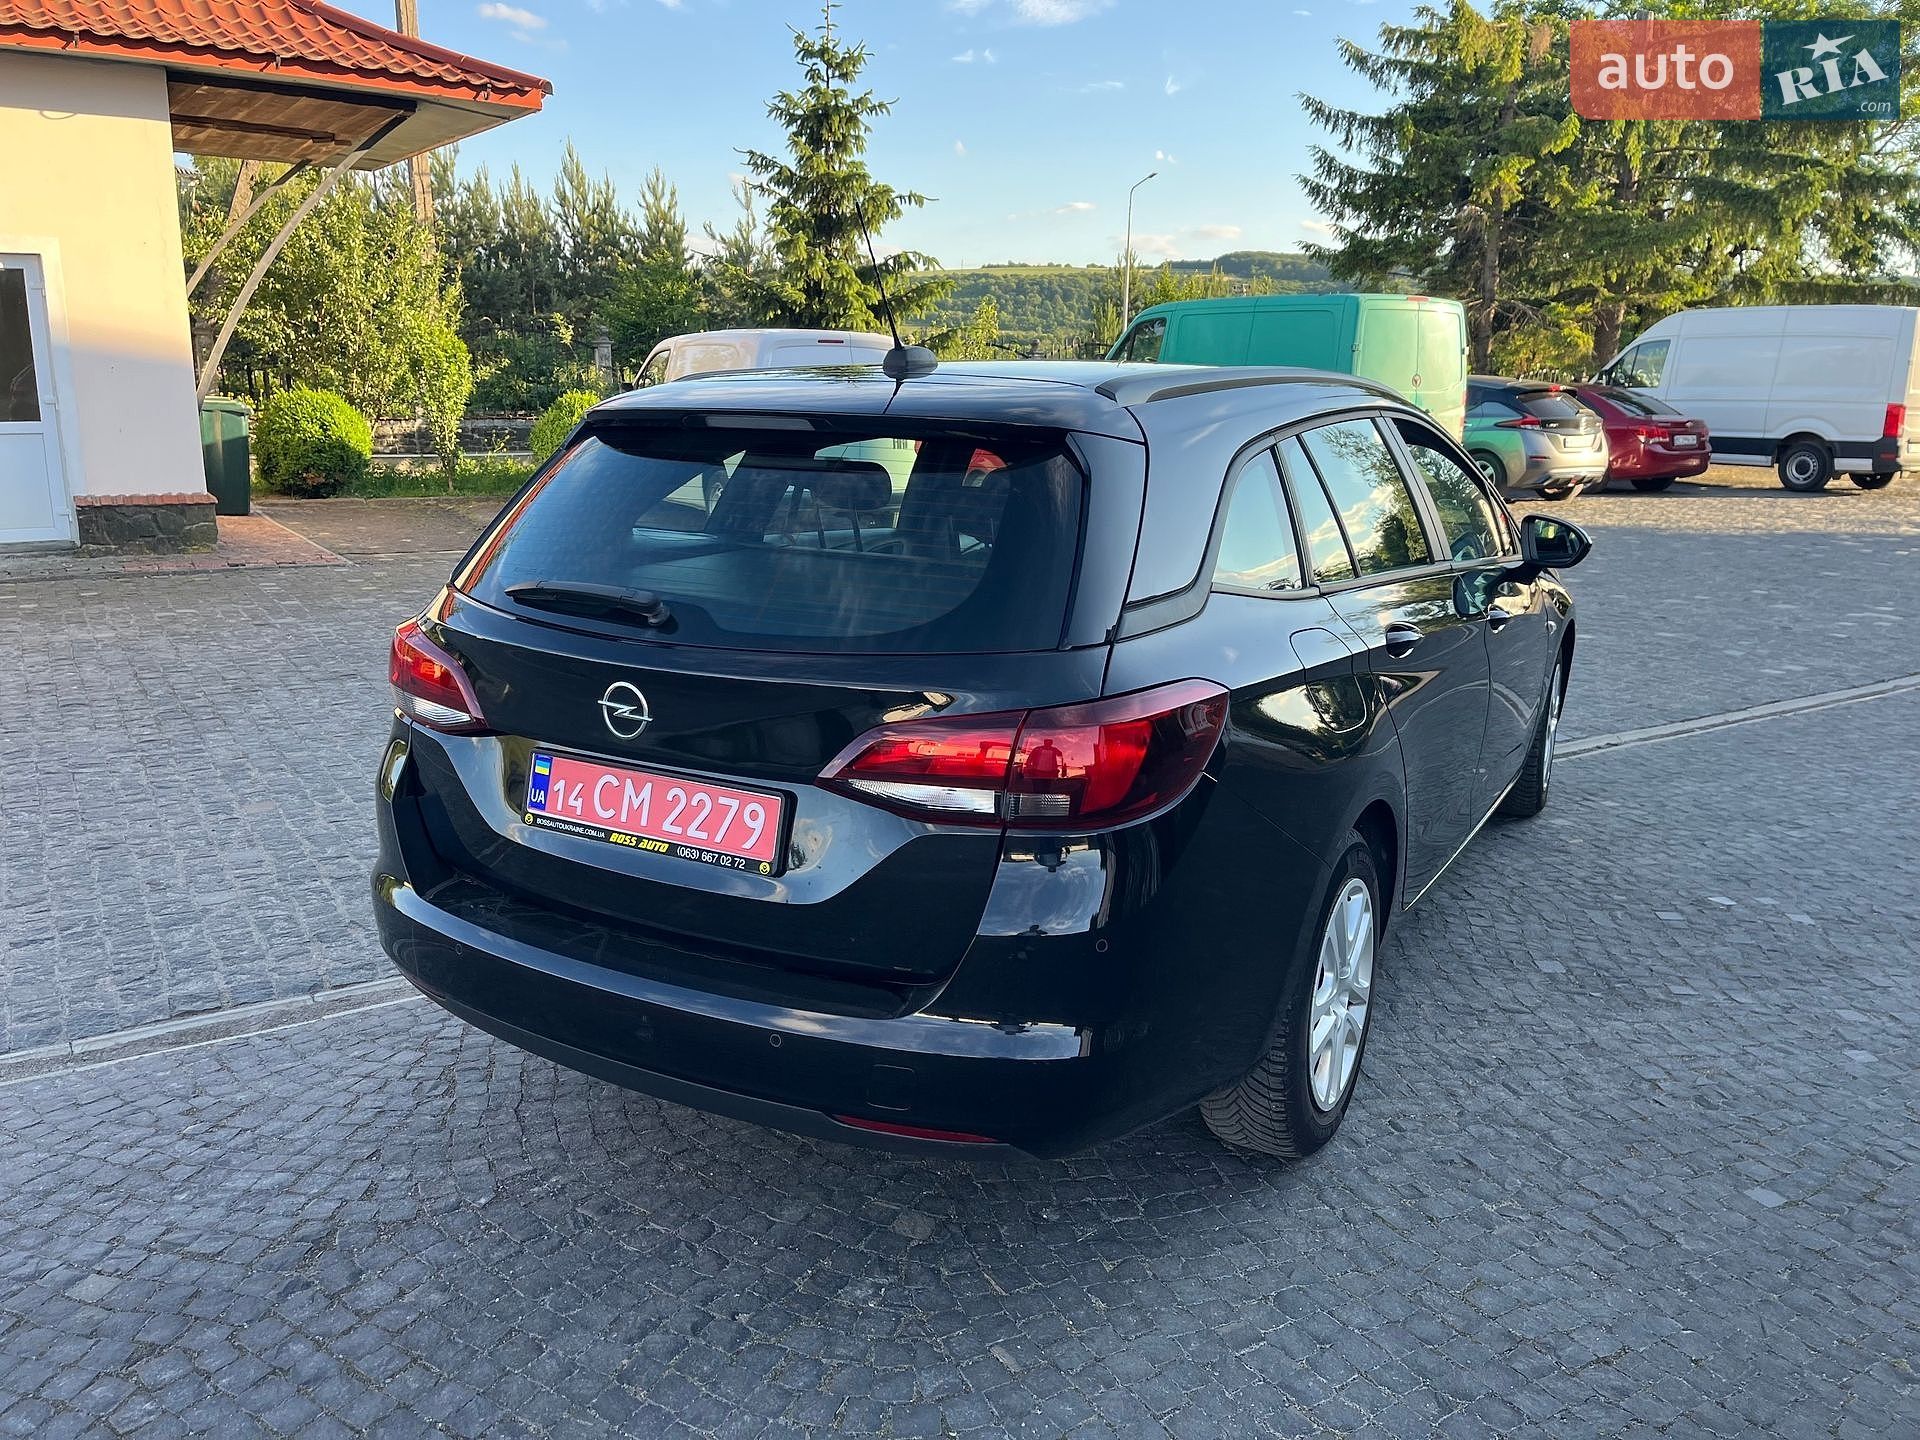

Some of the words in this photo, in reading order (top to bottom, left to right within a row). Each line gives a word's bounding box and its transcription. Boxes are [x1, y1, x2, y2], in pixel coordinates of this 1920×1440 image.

[531, 788, 545, 804] UA
[553, 779, 584, 816] 14
[593, 774, 653, 827] CM
[662, 787, 766, 850] 2279
[536, 817, 606, 839] BOSSAUTOUKRAINE.COM.UA
[609, 832, 638, 848] BOSS
[638, 839, 670, 854] AUTO
[676, 846, 700, 860] (063)
[701, 850, 718, 863] 667
[720, 855, 731, 866] 02
[734, 858, 746, 870] 72
